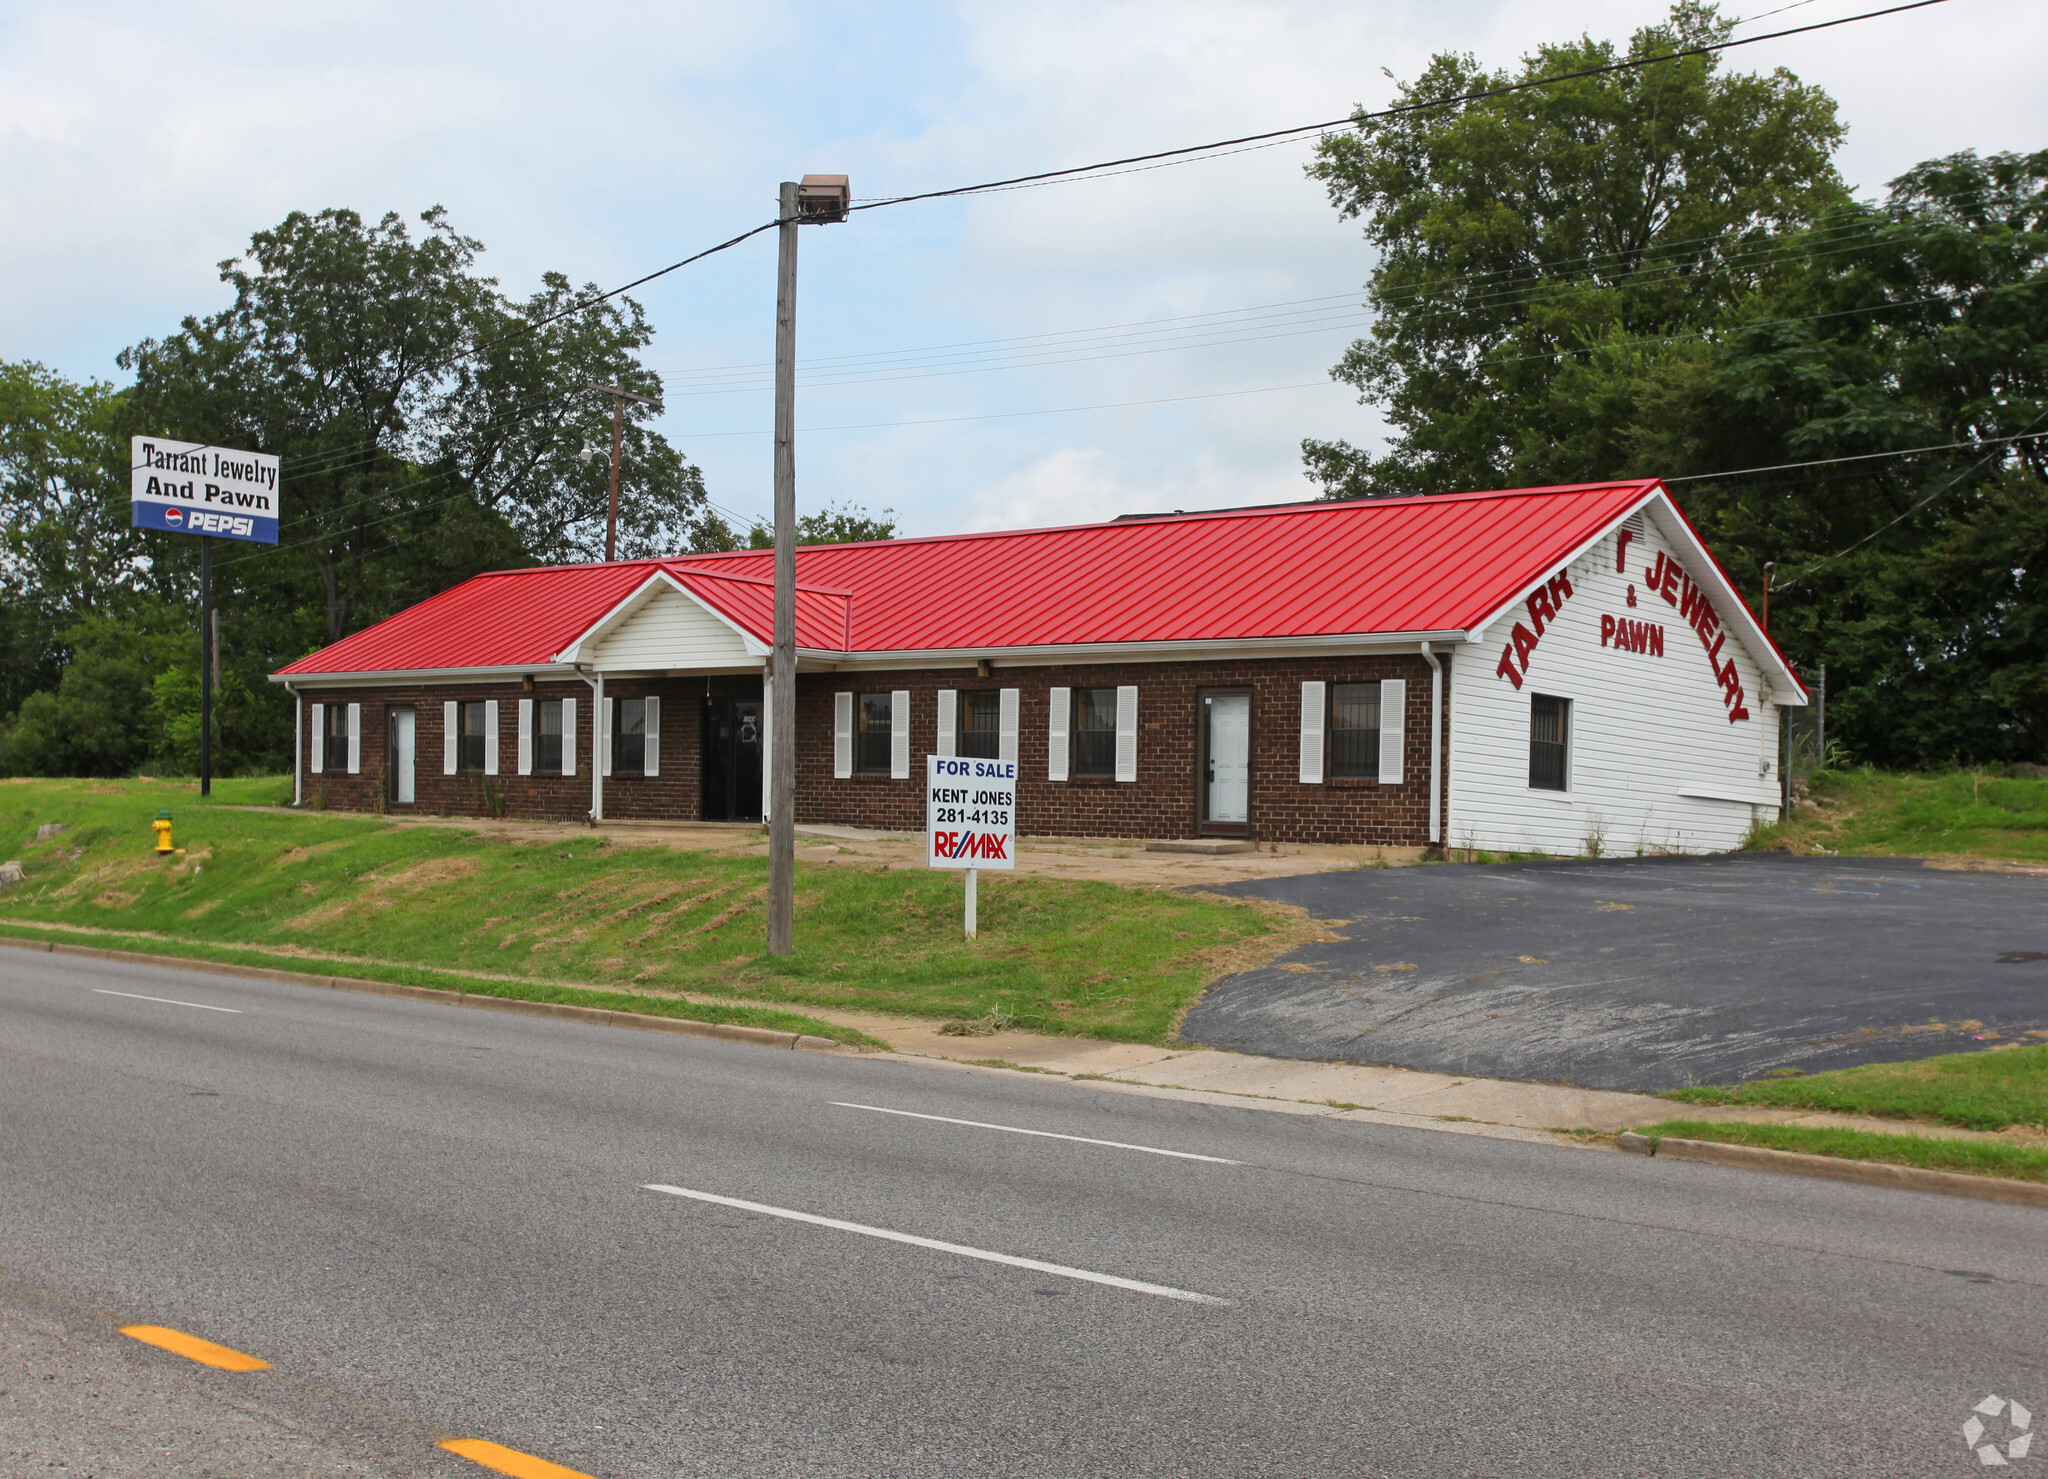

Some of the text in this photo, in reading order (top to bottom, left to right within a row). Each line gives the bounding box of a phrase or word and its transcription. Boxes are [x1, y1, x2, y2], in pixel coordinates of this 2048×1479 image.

[143, 443, 276, 491] Tarrant Jewelry
[145, 476, 270, 510] And Pawn
[188, 511, 254, 536] PEPSI
[1626, 584, 1637, 608] &
[1601, 614, 1663, 657] PAWN
[1645, 550, 1749, 724] JEWELRY
[937, 760, 1014, 778] FOR SALE
[932, 788, 1012, 806] KENT JONES
[936, 807, 1008, 825] 281-4135
[934, 830, 1008, 859] RE/MAX
